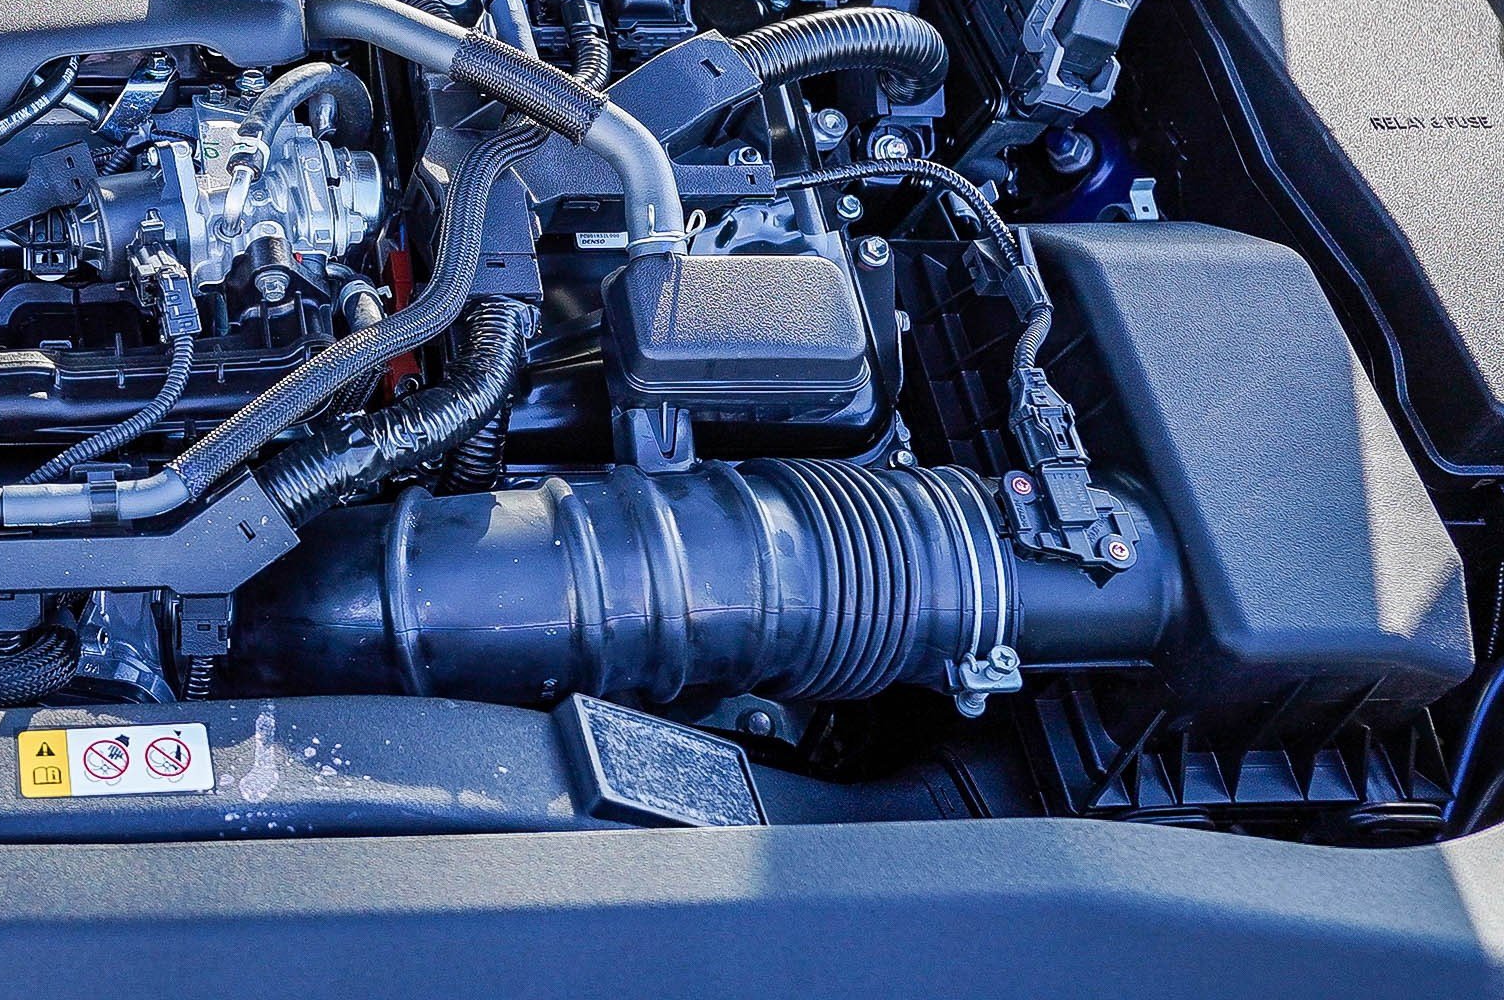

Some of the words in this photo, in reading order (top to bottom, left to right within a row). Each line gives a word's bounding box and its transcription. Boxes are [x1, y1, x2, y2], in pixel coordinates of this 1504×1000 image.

[1370, 117, 1426, 131] RELAY
[1430, 117, 1446, 129] &
[1444, 116, 1493, 130] FUSE
